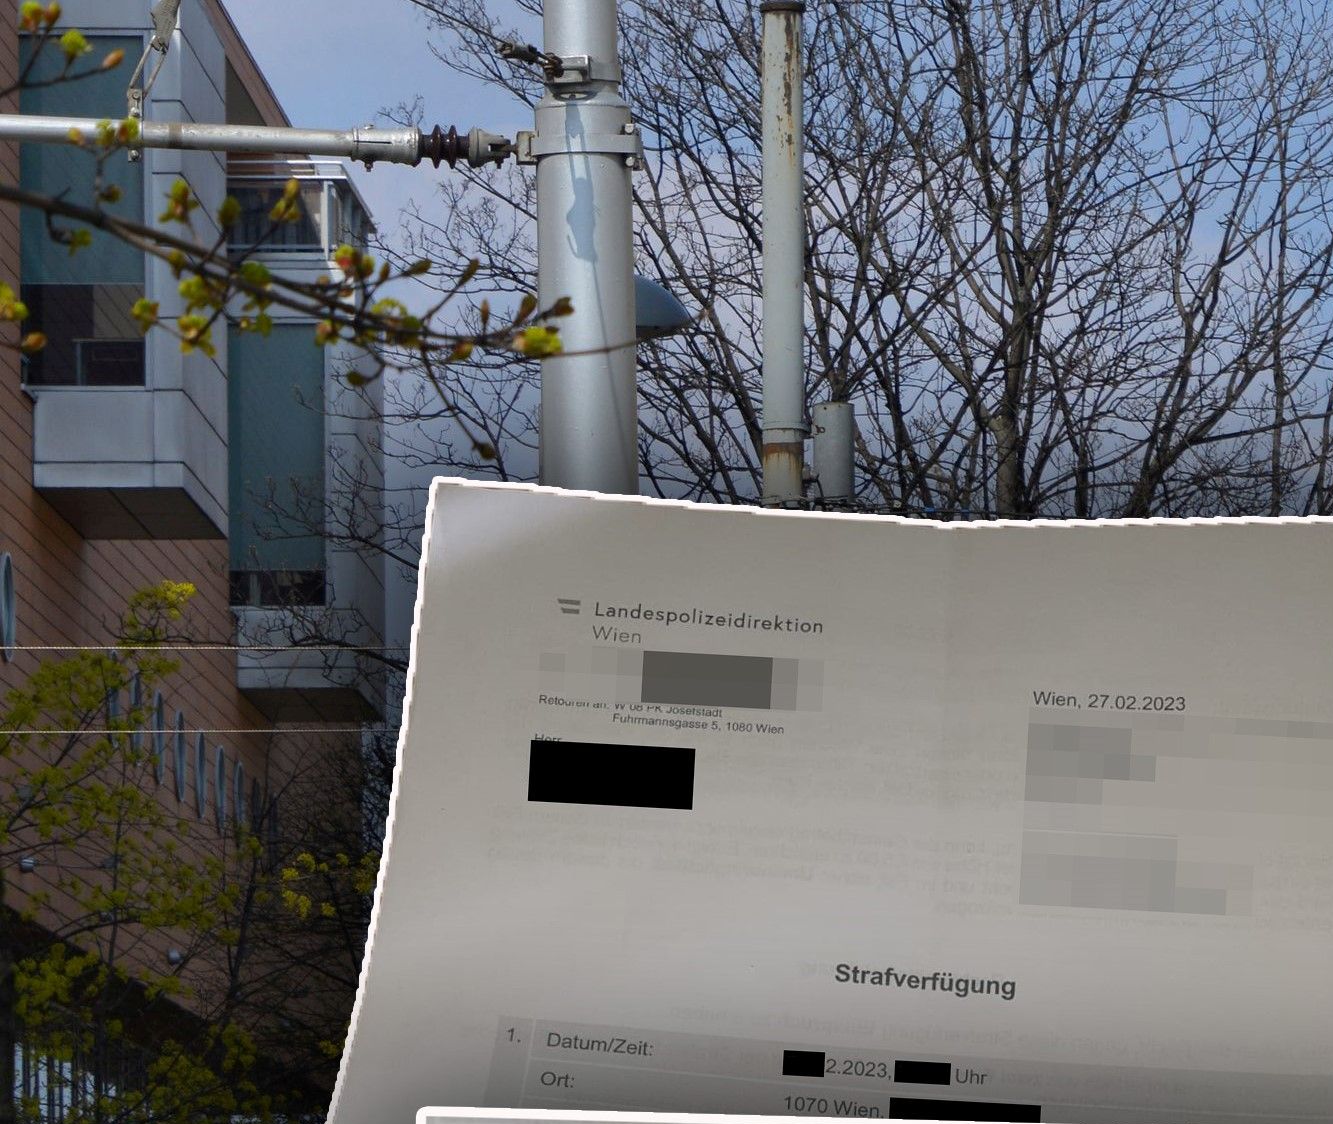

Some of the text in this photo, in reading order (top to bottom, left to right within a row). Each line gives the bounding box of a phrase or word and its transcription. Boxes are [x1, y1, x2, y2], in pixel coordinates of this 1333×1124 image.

[592, 600, 826, 635] Landespolizeidirektion
[592, 624, 642, 644] Wien
[1032, 690, 1186, 712] Wien, 27.02.2023
[612, 712, 785, 735] Fuhrmannsgasse 1080 Wien
[834, 962, 1017, 1002] Strafverfügung
[546, 1031, 654, 1057] Datum/Zeit:
[955, 1068, 989, 1086] Uhr
[540, 1070, 830, 1116] Ort: 1070
